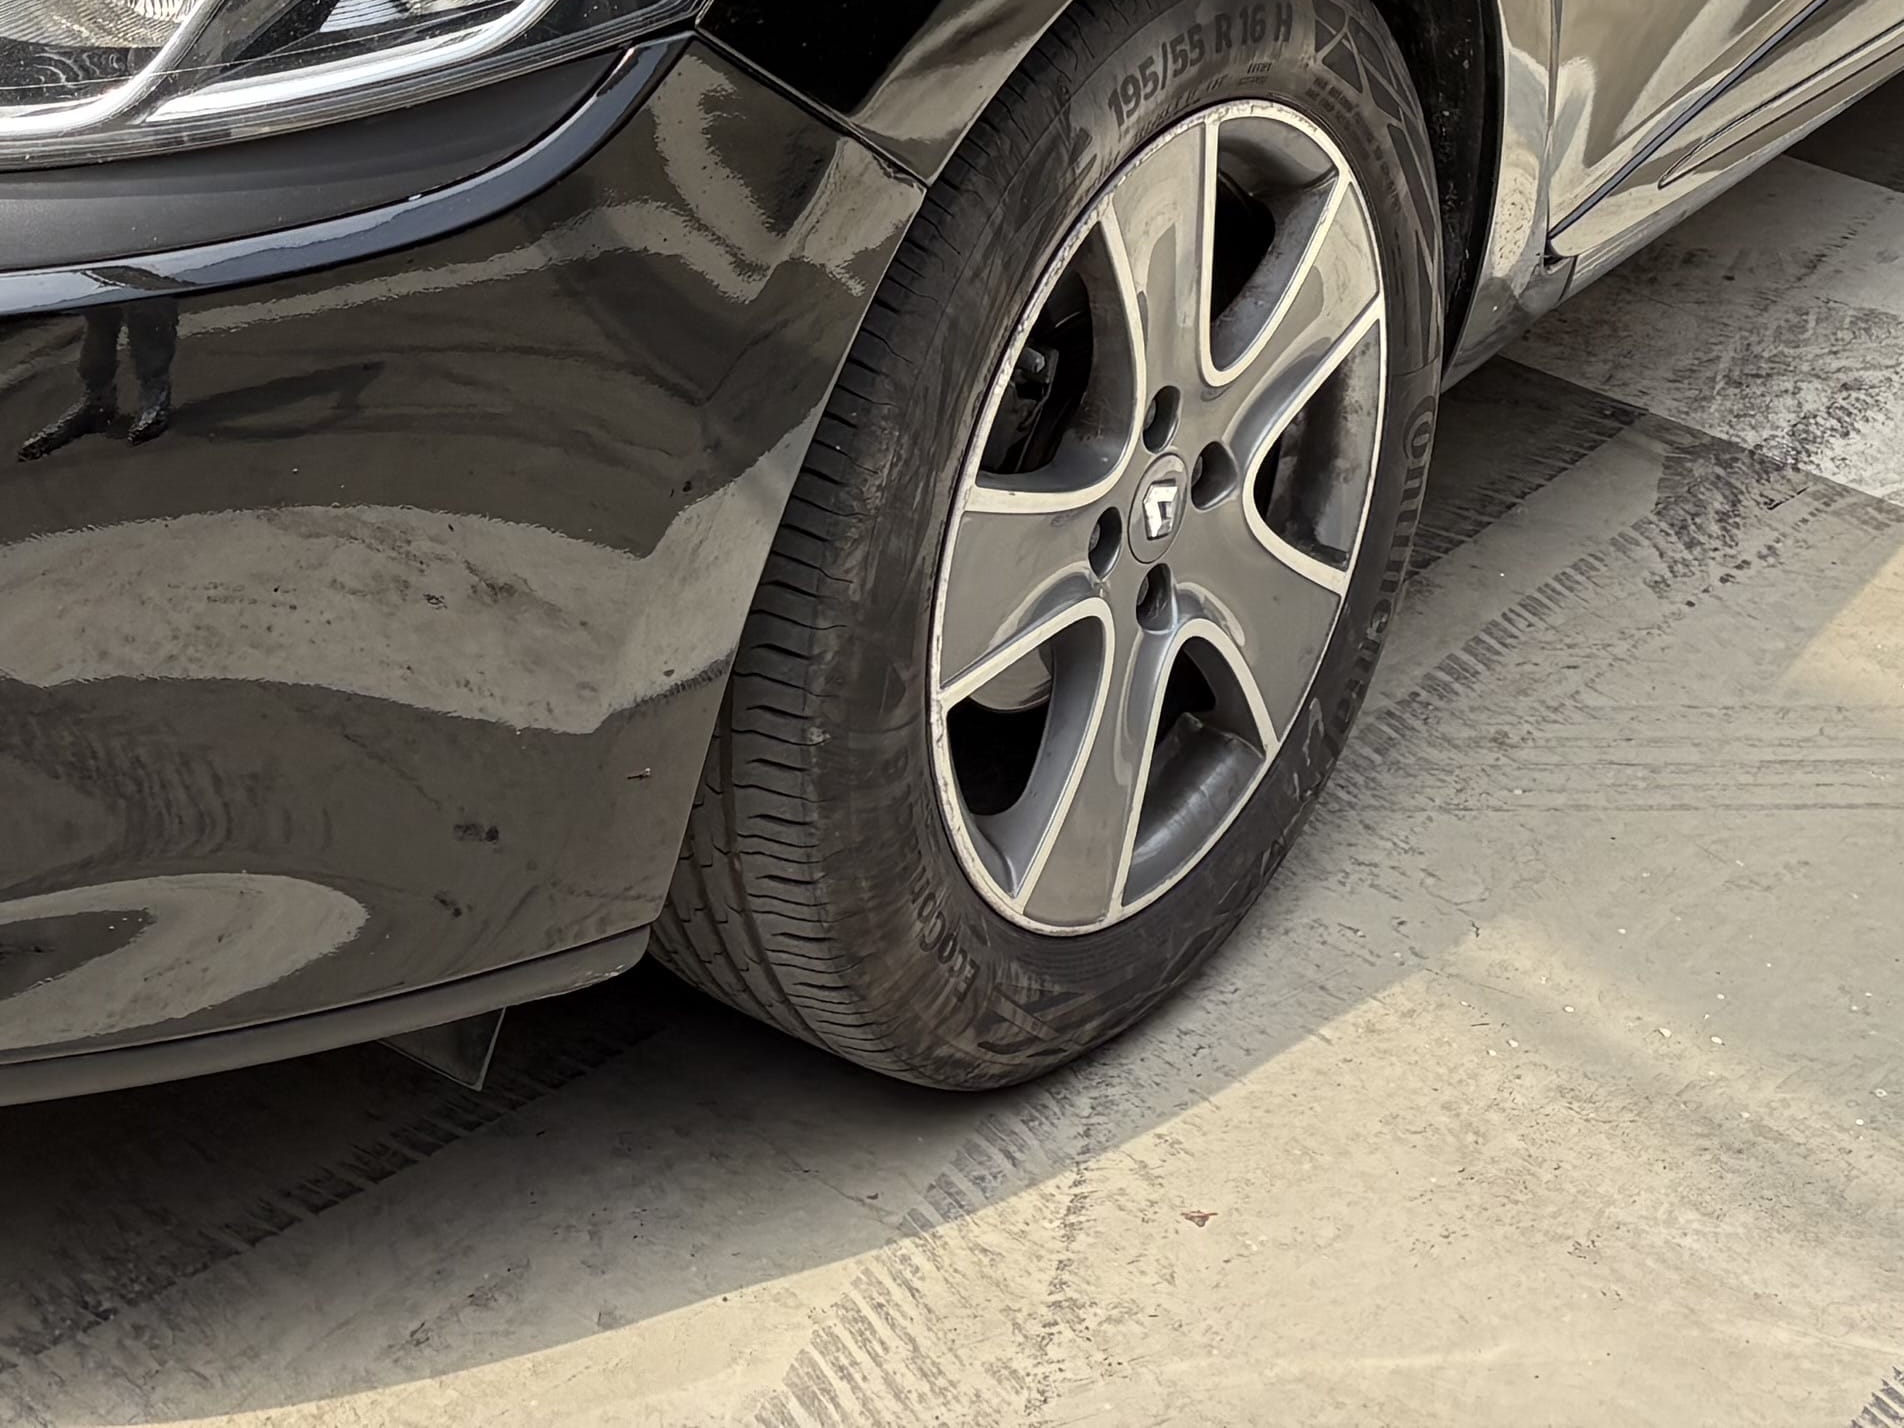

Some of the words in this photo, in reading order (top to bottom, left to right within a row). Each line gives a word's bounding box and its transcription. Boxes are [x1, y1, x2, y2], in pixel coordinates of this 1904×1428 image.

[1108, 22, 1206, 130] 195/55
[1214, 11, 1233, 54] R
[1239, 3, 1267, 46] 16
[1273, 0, 1294, 42] H
